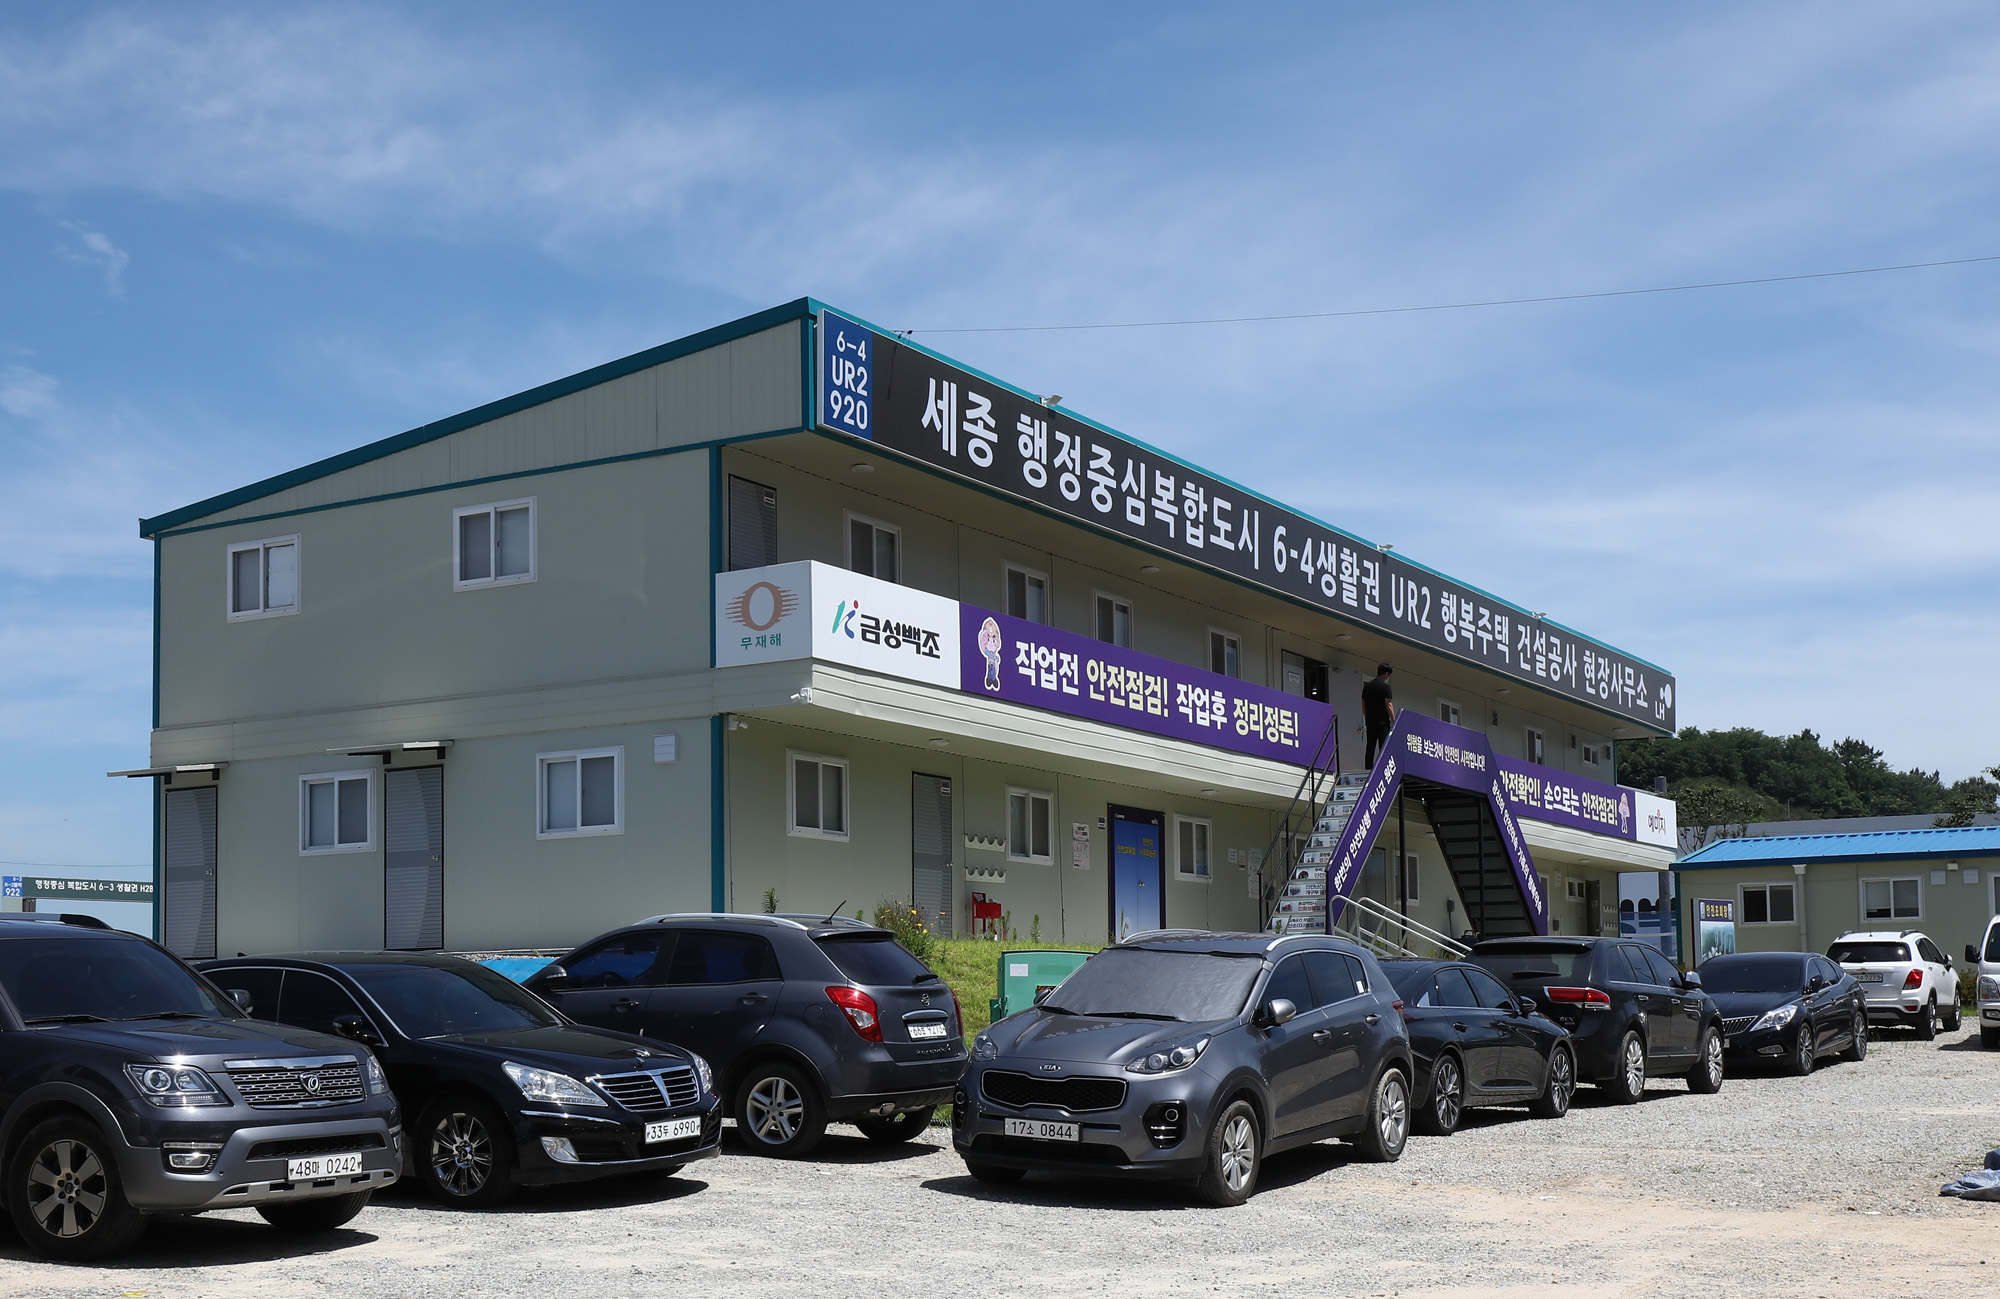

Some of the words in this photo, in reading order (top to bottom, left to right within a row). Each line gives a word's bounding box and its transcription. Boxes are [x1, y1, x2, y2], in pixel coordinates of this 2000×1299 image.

[836, 331, 867, 362] 6-4
[831, 357, 868, 397] UR2
[830, 390, 868, 431] 920
[921, 377, 998, 468] 세종
[1016, 412, 1260, 570] 행정중심복합도시
[1273, 525, 1380, 615] 6-4생활권
[1391, 573, 1431, 630] UR2
[1440, 590, 1510, 664] 행복주택
[1517, 623, 1577, 689] 건설공사
[1583, 649, 1648, 709] 현장사무소
[740, 632, 782, 650] 무재해
[860, 613, 941, 659] 금성백조
[1014, 639, 1080, 696] 작업전
[1086, 659, 1169, 717] 안전점검!
[1176, 686, 1228, 730] 작업후
[1232, 701, 1299, 749] 정리정돈!
[1655, 700, 1665, 721] LH
[1406, 733, 1423, 755] 위험을
[1423, 739, 1444, 761] 보는것이
[1444, 745, 1460, 766] 안전의
[1543, 781, 1580, 817] 손으로는
[1581, 792, 1618, 826] 안전점검!
[1333, 851, 1352, 893] 한번의
[1349, 809, 1372, 859] 안전실행
[1369, 780, 1386, 815] 무사고
[1648, 809, 1666, 835] 예미지
[5, 888, 20, 897] 922
[35, 879, 65, 890] 행정중심
[67, 881, 97, 892] 복합도시
[98, 882, 115, 892] 6-3
[116, 883, 138, 893] 생활권
[650, 1125, 669, 1140] 33두
[673, 1120, 696, 1136] 6990
[1011, 1121, 1034, 1136] 17소
[1040, 1123, 1073, 1139] 0844
[295, 1160, 320, 1177] 48마
[326, 1156, 356, 1174] 0242
